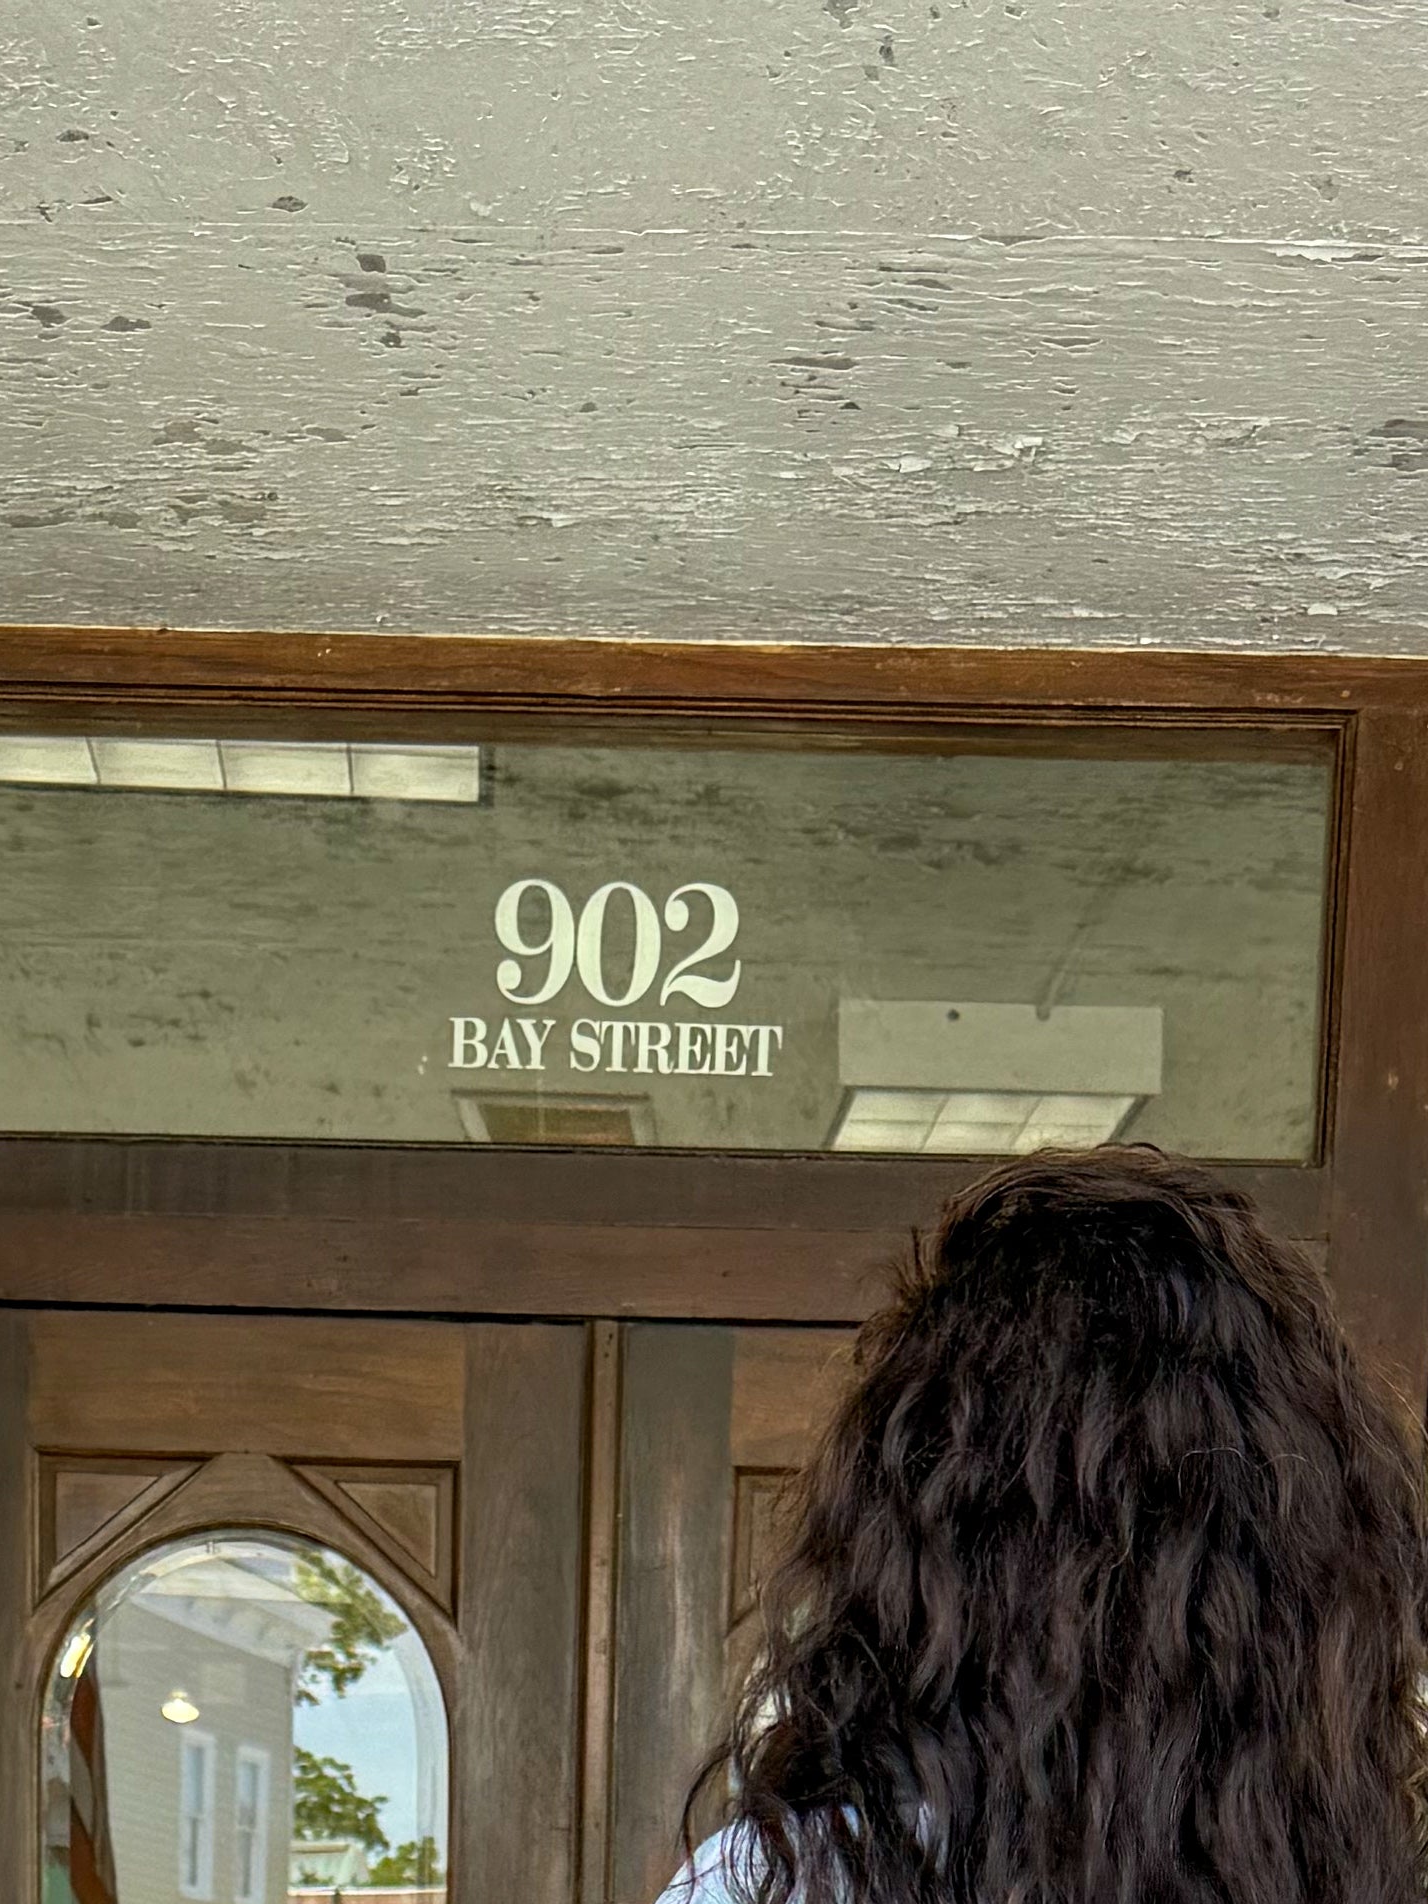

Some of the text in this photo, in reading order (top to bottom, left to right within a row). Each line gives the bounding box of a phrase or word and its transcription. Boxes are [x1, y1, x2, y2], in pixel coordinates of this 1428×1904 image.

[495, 879, 741, 1008] 902
[448, 1017, 783, 1077] BAY STREET
